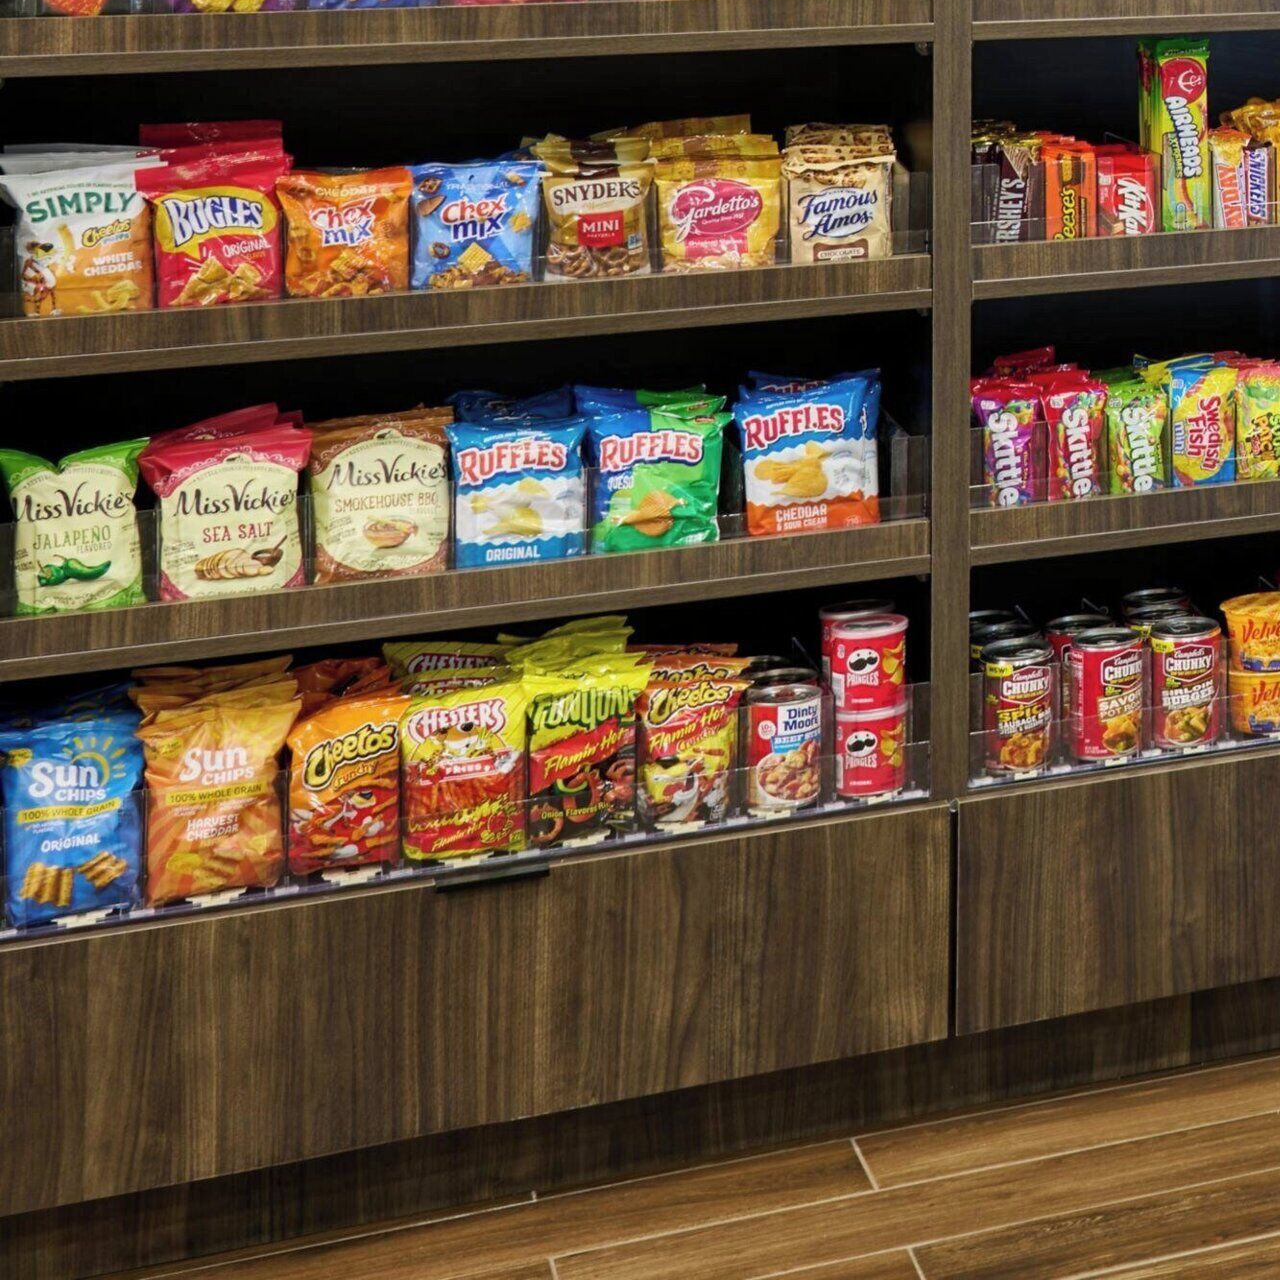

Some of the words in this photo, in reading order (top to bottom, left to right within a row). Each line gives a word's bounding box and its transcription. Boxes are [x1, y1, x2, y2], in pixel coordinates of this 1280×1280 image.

[1164, 96, 1203, 178] AIRHEADS
[1249, 148, 1267, 220] SNICKERS
[26, 191, 136, 223] SIMPLY
[442, 194, 507, 222] Chex
[796, 187, 878, 225] Famous
[163, 194, 264, 247] BUGLES
[451, 214, 502, 241] mix
[582, 220, 620, 233] MINI
[802, 211, 870, 242] Amos
[83, 261, 142, 277] CHEDDAR
[93, 252, 134, 265] WHITE
[745, 403, 845, 449] RUFFLES
[1187, 413, 1207, 458] Fish
[1199, 395, 1222, 471] Swedish
[457, 441, 567, 485] RUFFLES
[600, 431, 703, 472] RUFFLES
[607, 476, 635, 489] QUESO
[335, 493, 415, 514] SMOKEHOUSE
[775, 504, 828, 521] CHEDDAR
[33, 524, 112, 551] JALAPEÑO
[202, 526, 233, 543] SEA
[238, 520, 274, 539] SALT
[486, 547, 541, 560] ORIGINAL
[1165, 654, 1212, 673] CHUNKY
[846, 671, 879, 686] PRINGLES
[1002, 677, 1050, 696] CHUNKY
[648, 682, 731, 726] Cheetos
[786, 707, 817, 721] Dinty
[408, 698, 506, 743] CHESTER'S
[180, 746, 248, 783] Sun
[303, 723, 397, 791] Cheetos
[845, 753, 877, 768] PRINGLES
[28, 762, 99, 798] Sun
[201, 767, 255, 786] CHIPS
[55, 786, 106, 802] CHIPS
[170, 792, 197, 804] 100%
[200, 789, 231, 801] WHOLE
[234, 784, 262, 796] GRAIN
[23, 808, 50, 820] 100%
[41, 834, 101, 854] ORIGINAL
